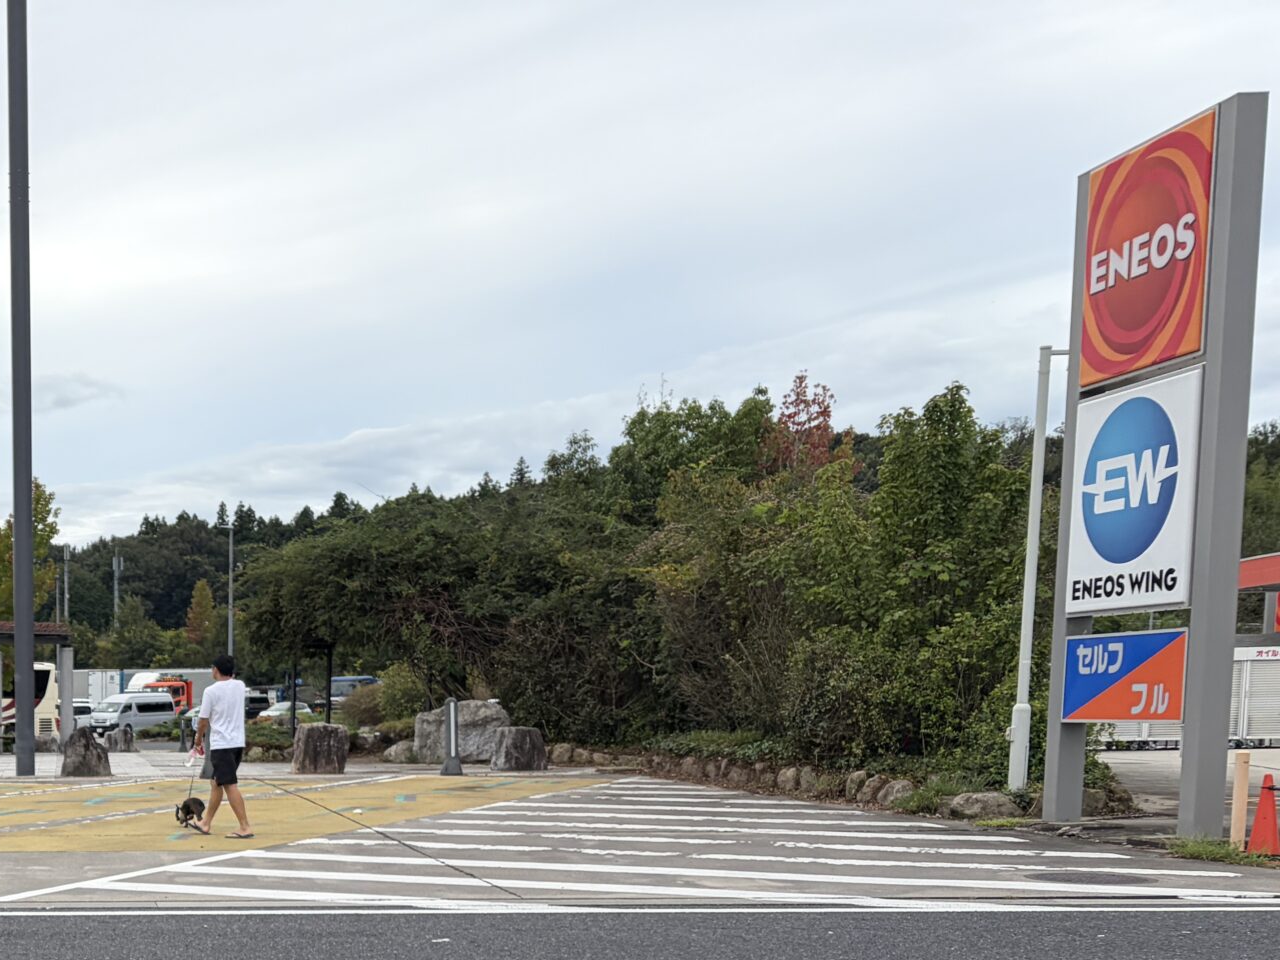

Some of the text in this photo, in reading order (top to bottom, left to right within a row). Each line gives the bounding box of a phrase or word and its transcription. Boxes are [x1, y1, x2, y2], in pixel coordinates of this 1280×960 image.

[1089, 212, 1196, 296] ENEOS
[1086, 444, 1176, 514] EW
[1072, 567, 1178, 601] ENEOS WING
[1076, 642, 1124, 675] セルフ
[1131, 683, 1169, 715] フル
